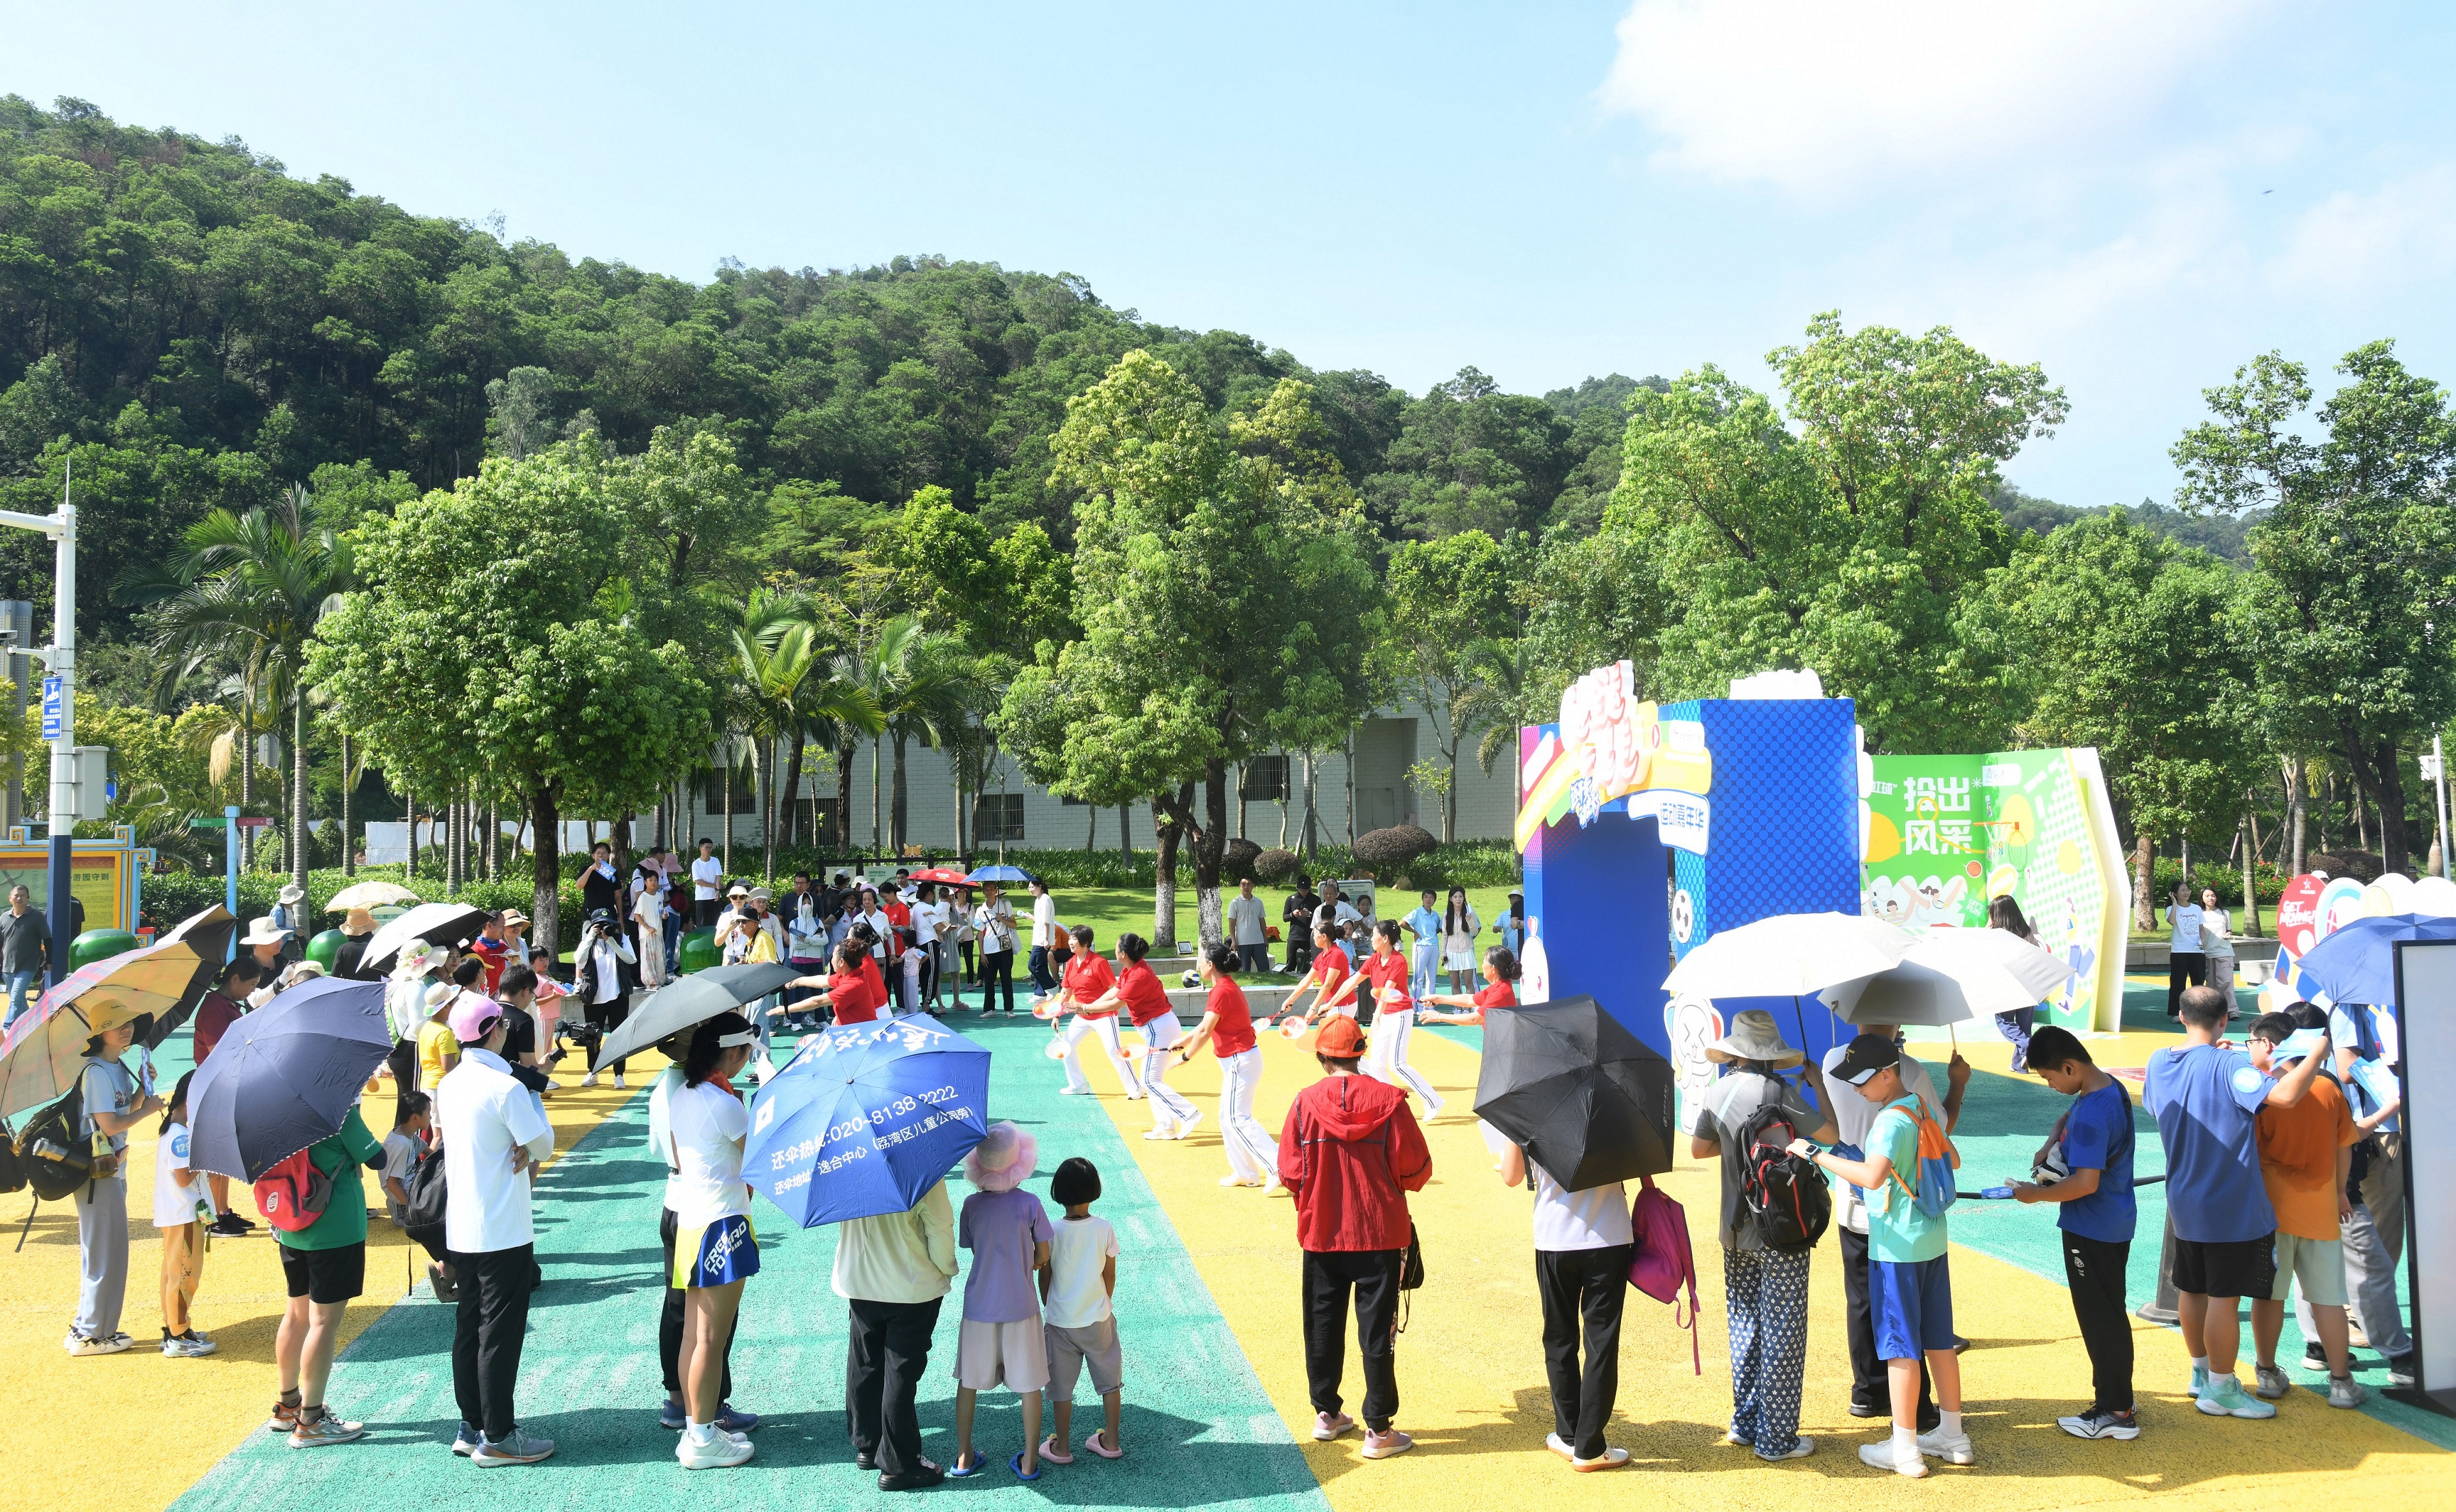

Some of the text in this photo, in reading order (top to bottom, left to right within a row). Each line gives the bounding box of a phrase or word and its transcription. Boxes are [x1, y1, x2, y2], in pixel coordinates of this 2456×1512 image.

[1903, 777, 1970, 812] 投出
[1661, 802, 1705, 832] 运动嘉年华
[1905, 820, 1973, 855] 风采
[73, 873, 110, 882] 游园守则
[2283, 901, 2305, 913] GET
[703, 1230, 728, 1272] FREE
[709, 1255, 726, 1276] TO
